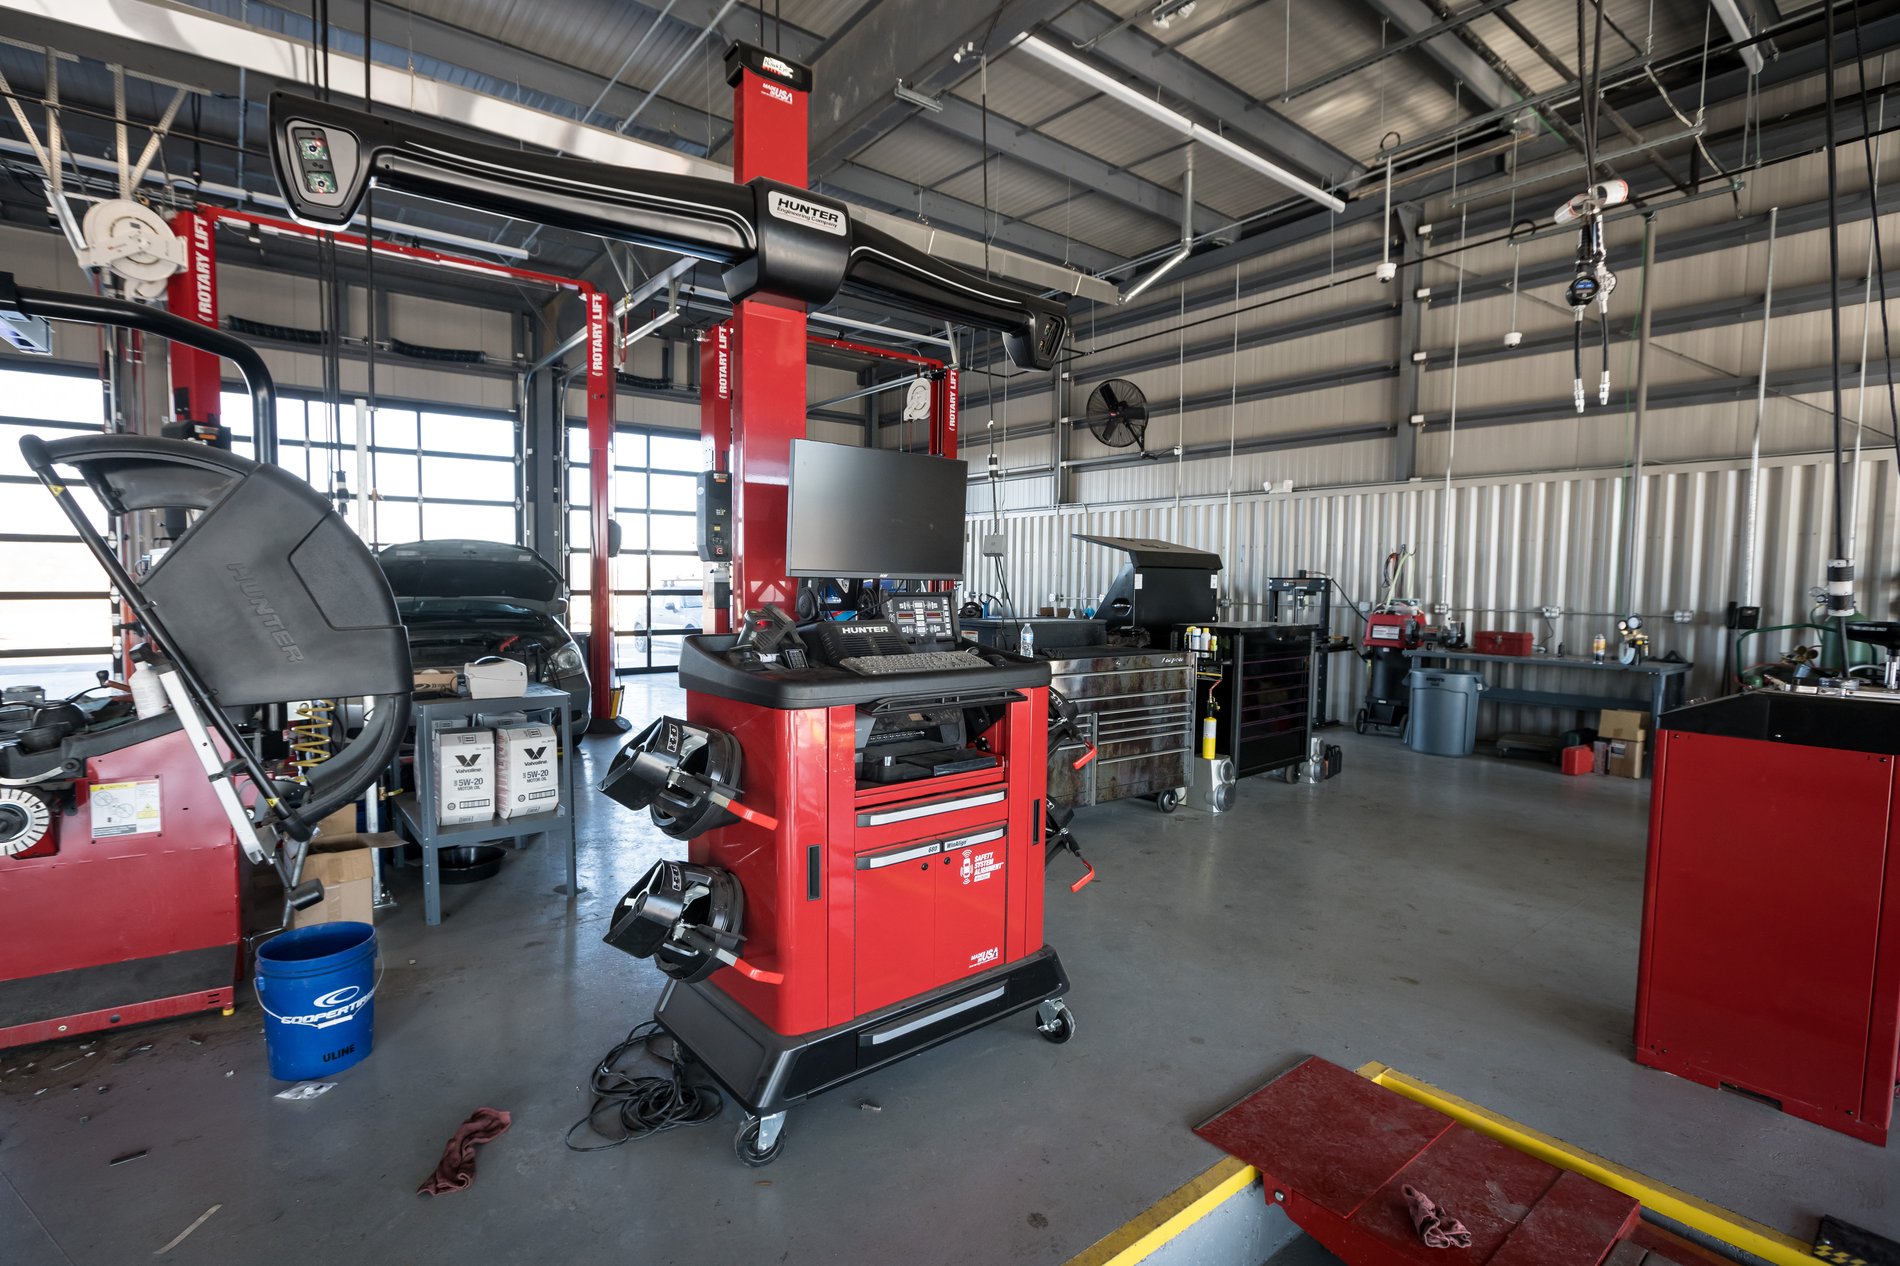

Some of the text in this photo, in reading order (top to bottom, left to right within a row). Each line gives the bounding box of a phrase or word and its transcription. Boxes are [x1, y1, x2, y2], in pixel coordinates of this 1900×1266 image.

[776, 88, 793, 103] USA
[776, 206, 838, 229] Engineering Company
[778, 198, 839, 223] HUNTER
[193, 214, 213, 314] ROTARY LIFT
[592, 293, 603, 371] ROTARY LIFT
[718, 326, 728, 394] ROTARY LIFT
[949, 370, 957, 427] ROTARY LIFT
[224, 562, 304, 663] HUNTER
[842, 626, 889, 634] HUNTER
[458, 777, 483, 786] 5W-20
[527, 769, 549, 779] 5W-20
[928, 845, 938, 853] 680
[974, 852, 994, 862] SAFETY
[974, 858, 994, 869] SYSTEM
[983, 947, 998, 961] USA
[323, 1044, 355, 1062] ULINE
